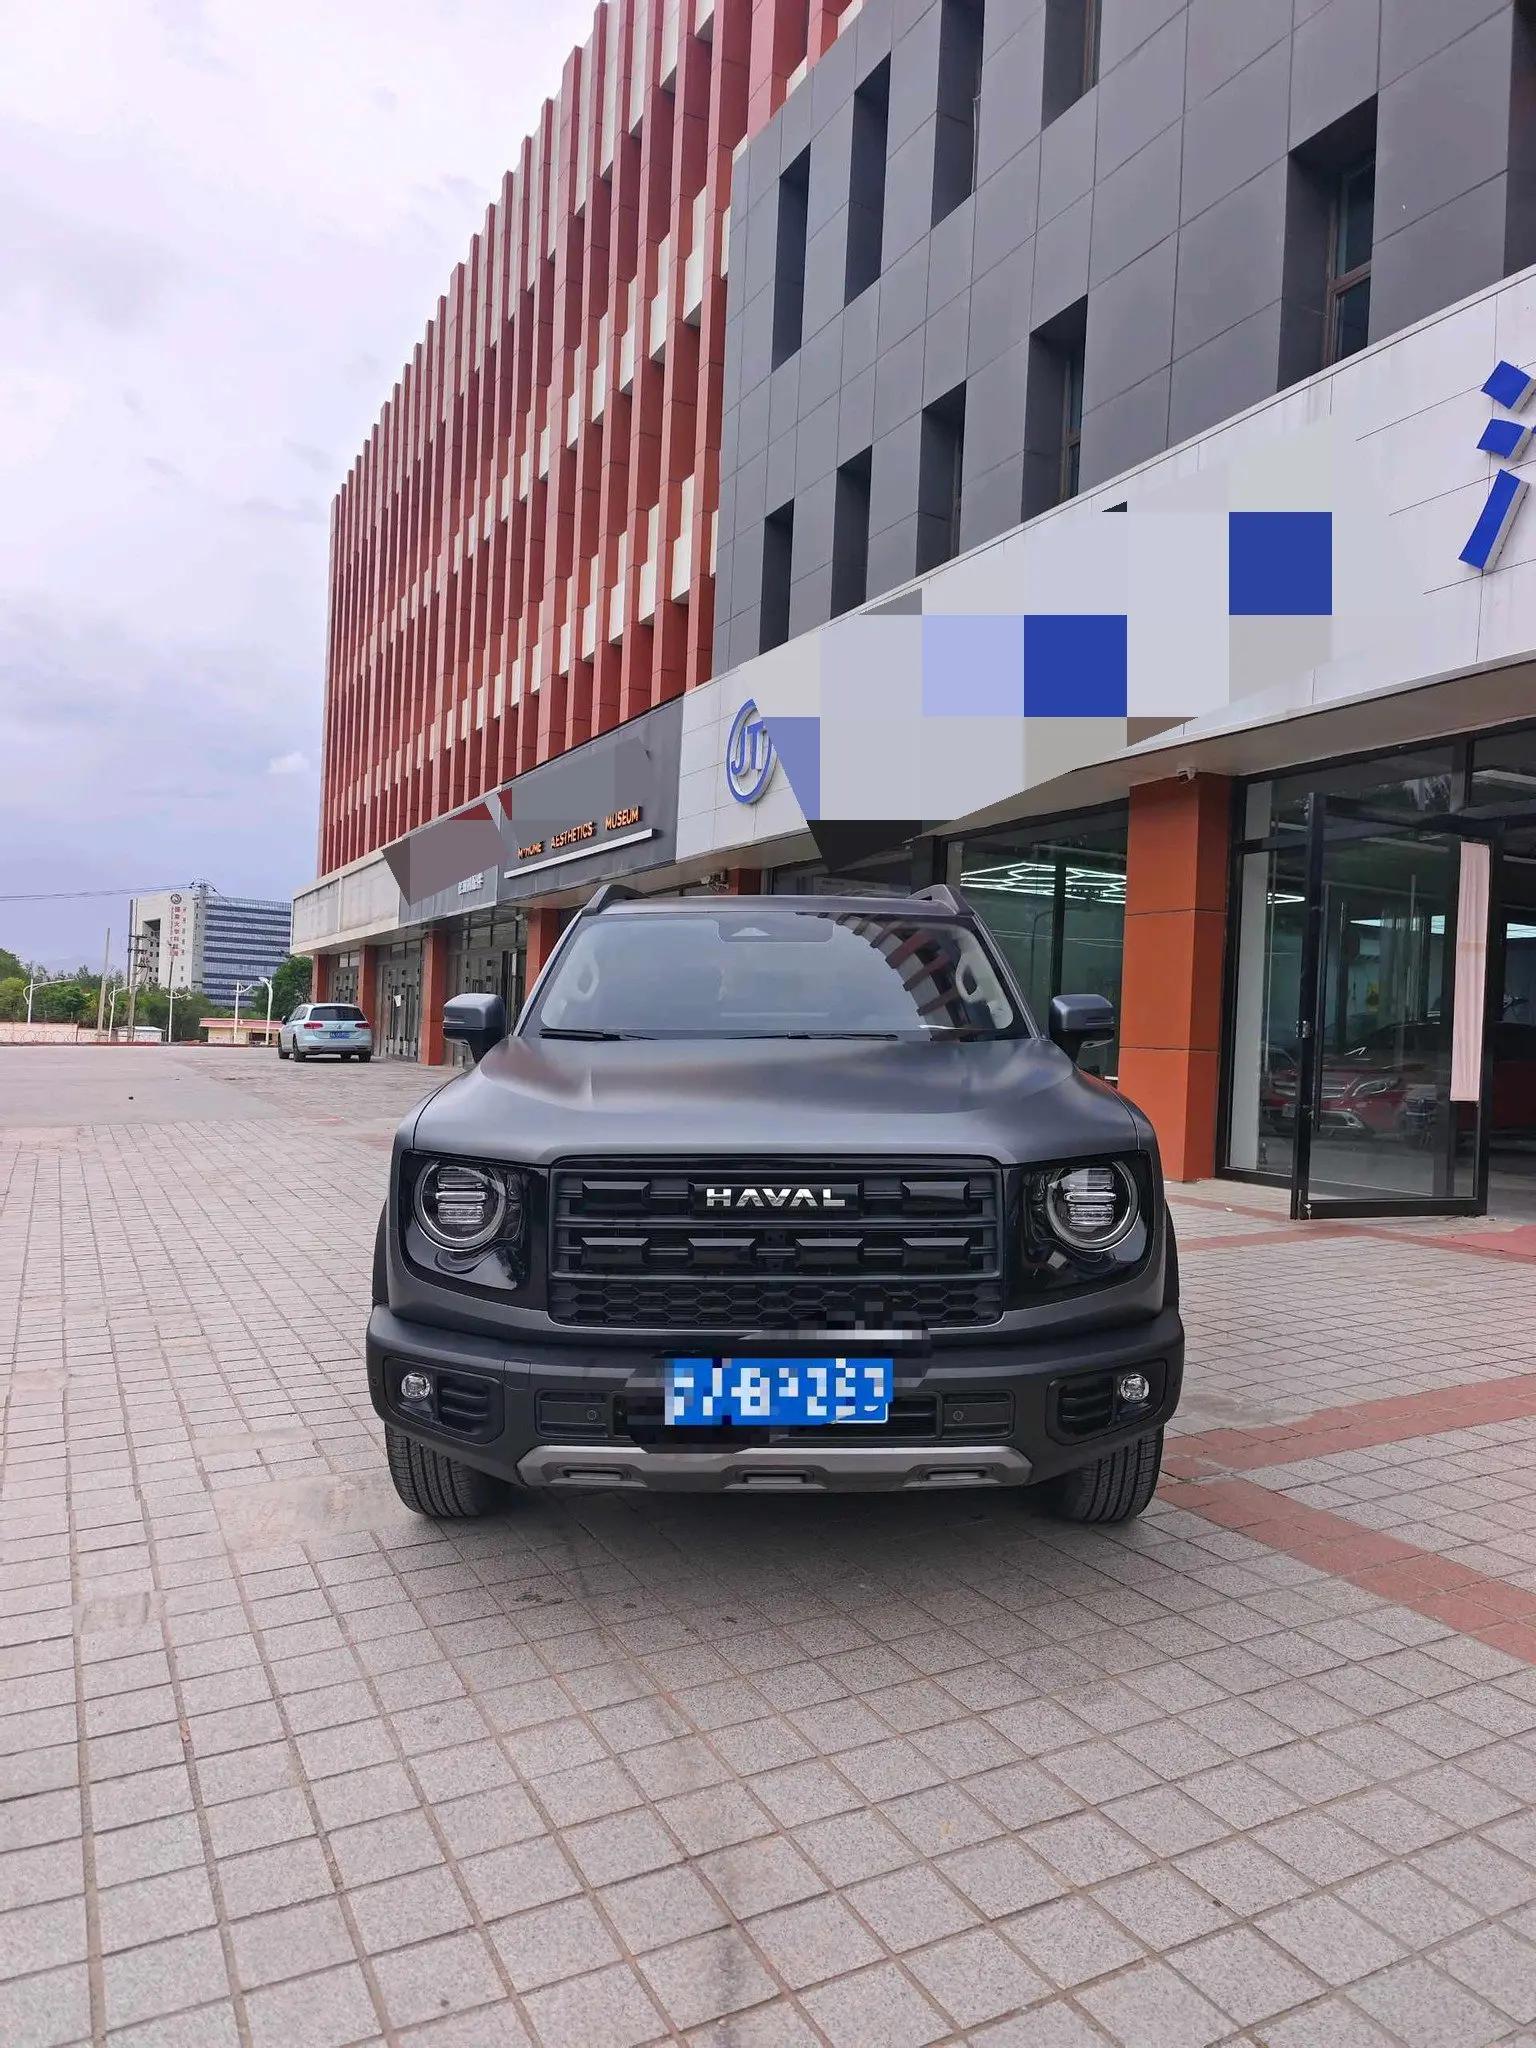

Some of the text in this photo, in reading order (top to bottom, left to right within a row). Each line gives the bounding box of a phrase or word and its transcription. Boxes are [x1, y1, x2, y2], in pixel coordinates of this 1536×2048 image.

[551, 821, 595, 849] AESTHETICS
[605, 806, 641, 831] MUSEUM
[706, 1188, 846, 1207] HAVAL
